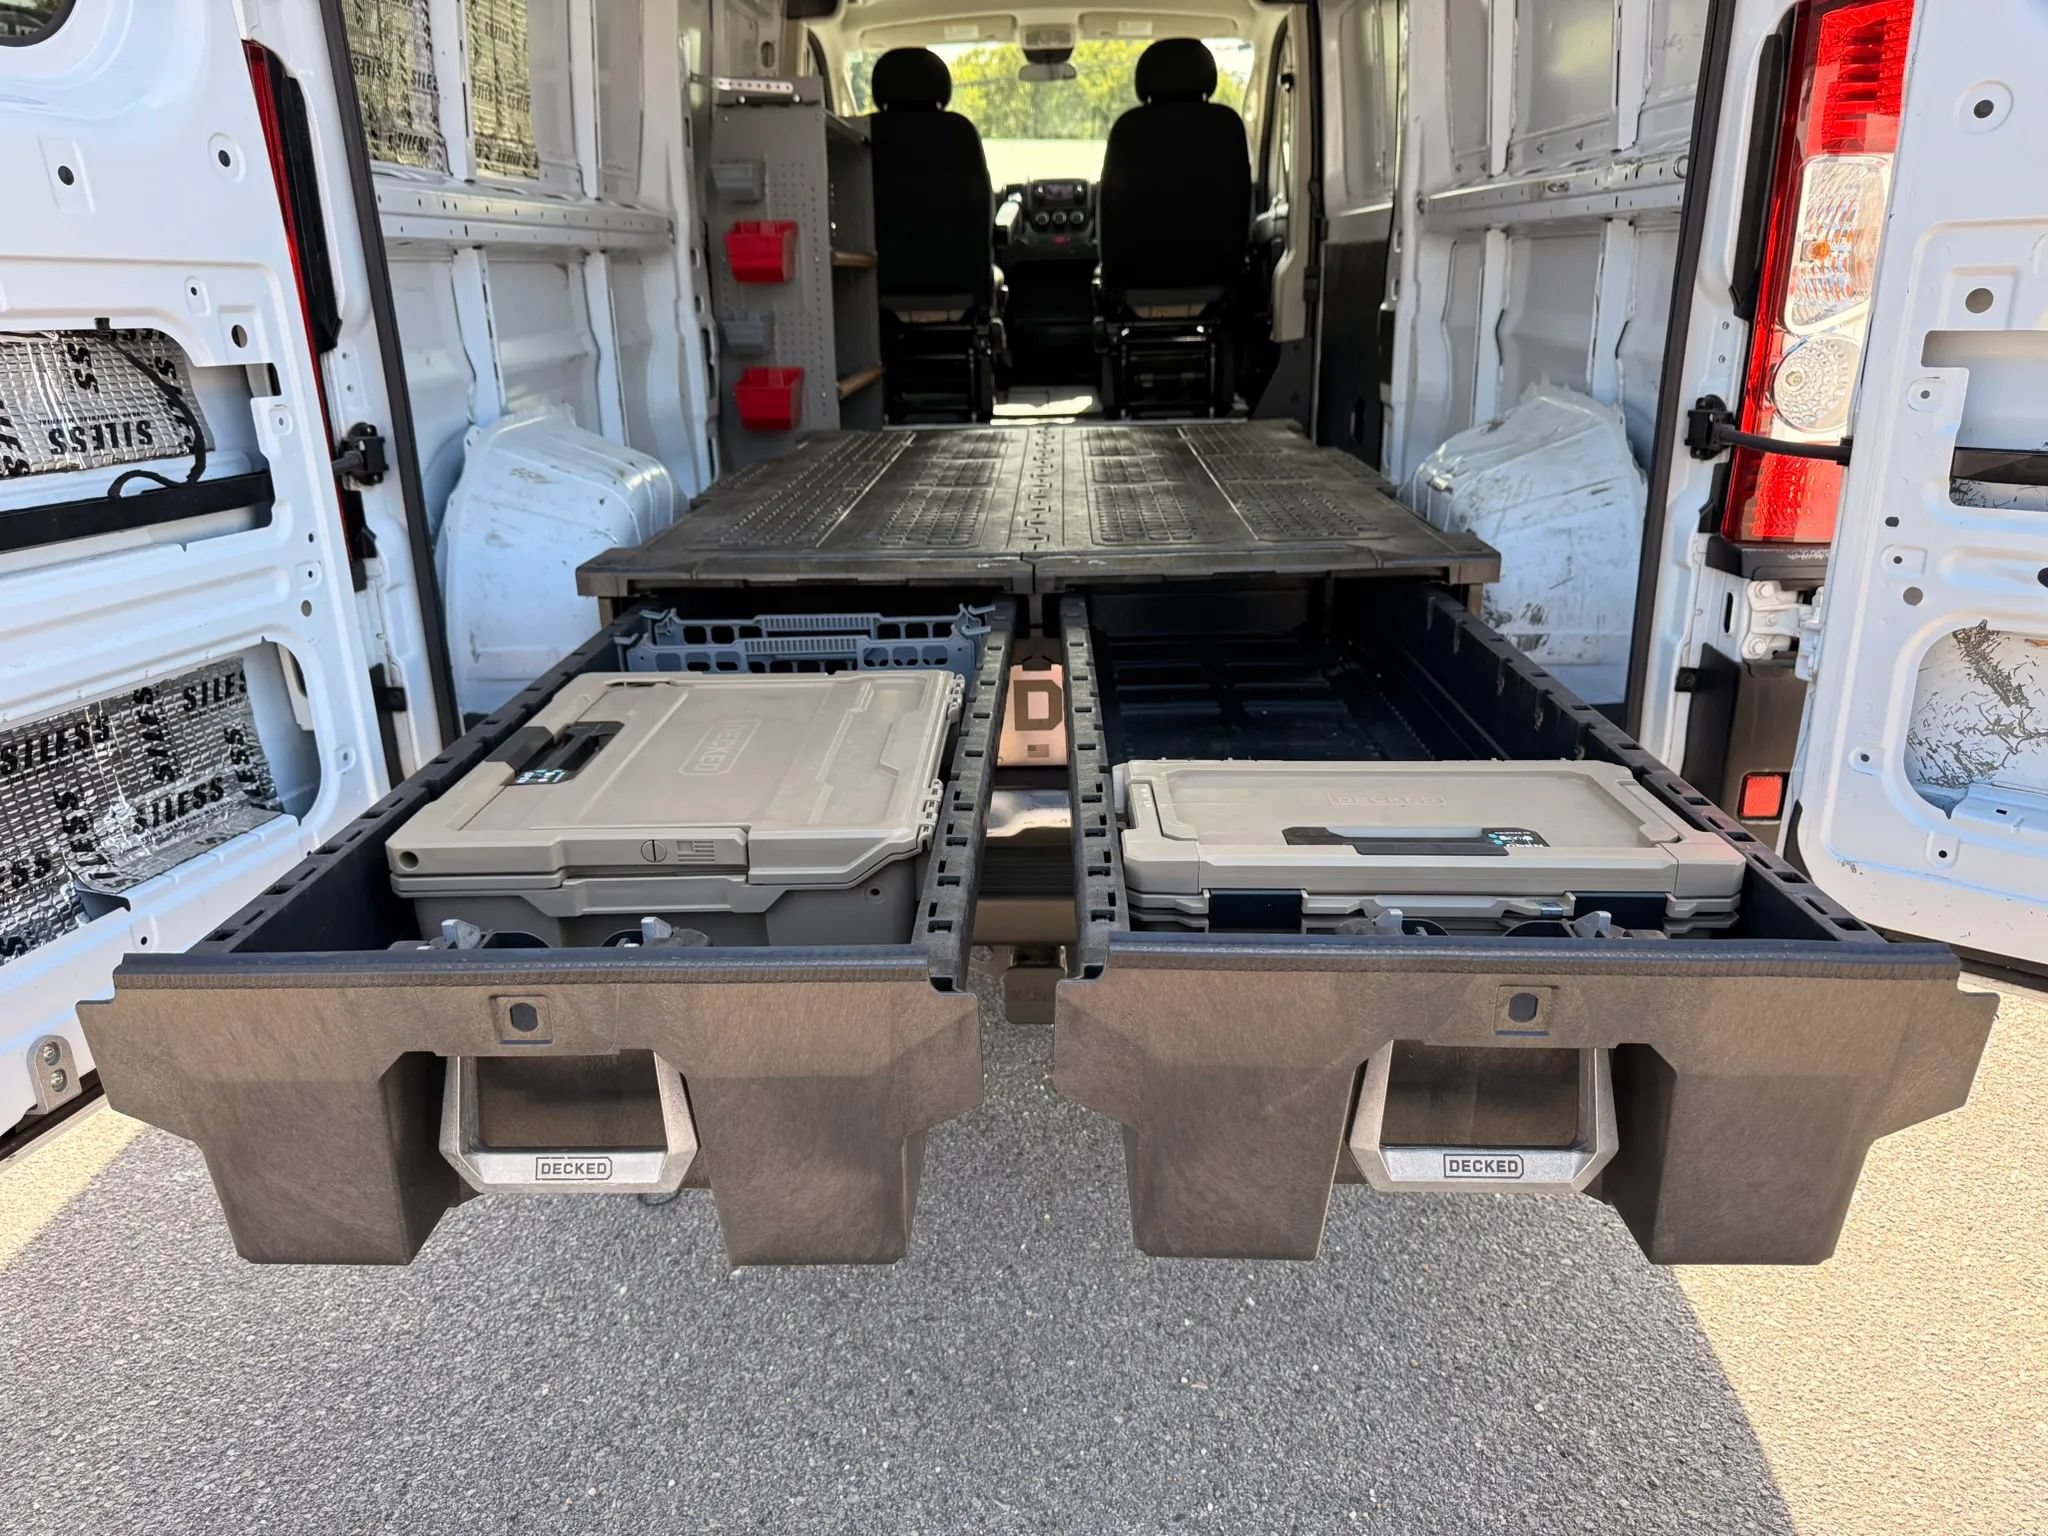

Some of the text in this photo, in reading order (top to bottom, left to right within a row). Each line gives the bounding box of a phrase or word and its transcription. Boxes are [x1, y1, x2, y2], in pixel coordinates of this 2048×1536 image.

[48, 420, 153, 455] SILESS
[0, 714, 111, 775] SILESS
[132, 686, 176, 783] SILES
[541, 1162, 607, 1175] DECKED
[1449, 1159, 1519, 1173] DECKED
